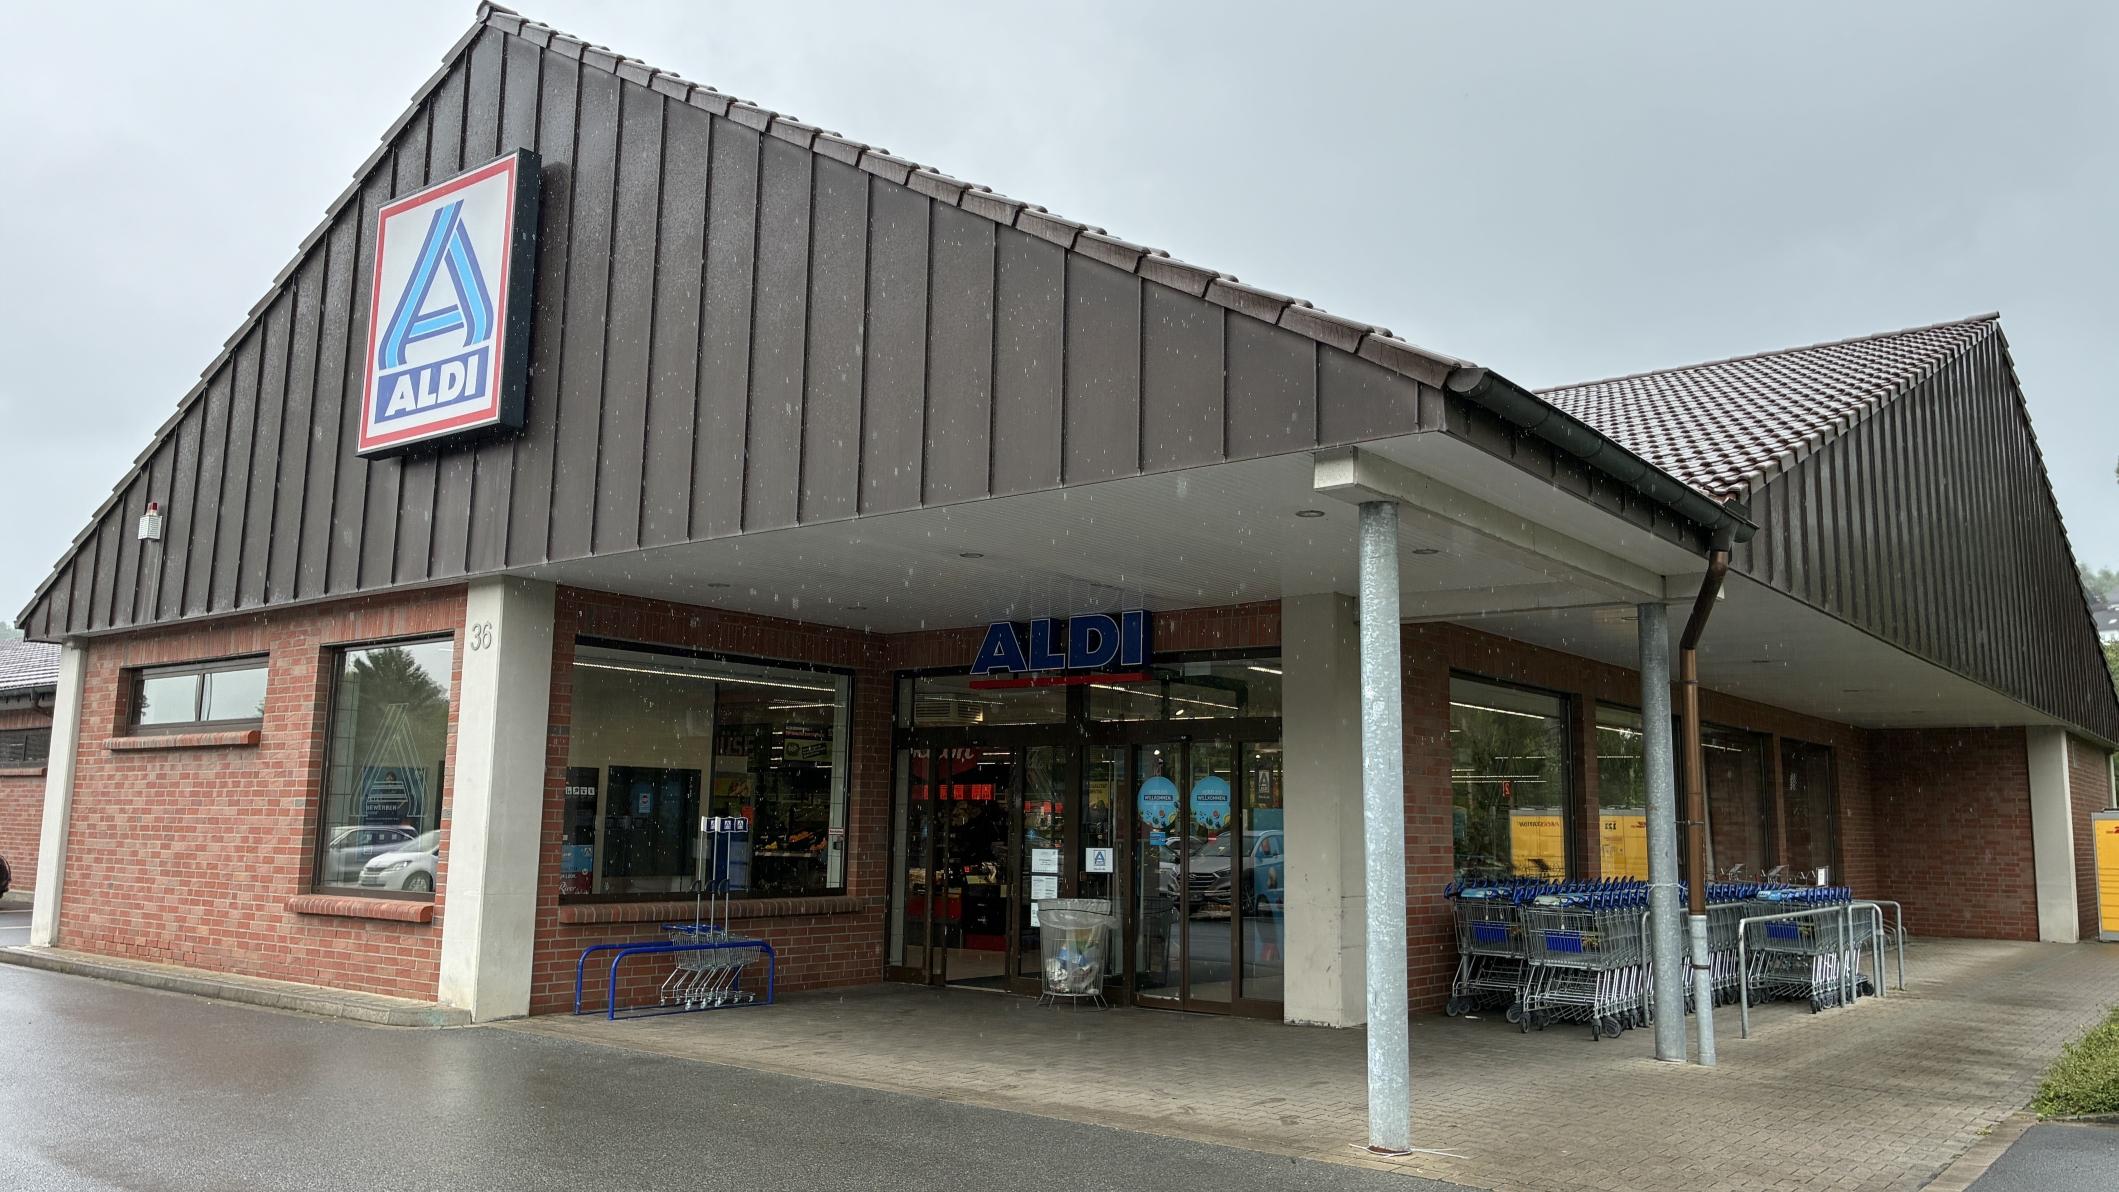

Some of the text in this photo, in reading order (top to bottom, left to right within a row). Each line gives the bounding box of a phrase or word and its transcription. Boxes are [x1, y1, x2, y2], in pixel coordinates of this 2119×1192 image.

[384, 355, 479, 417] ALDI
[470, 621, 493, 651] 36
[970, 609, 1151, 675] ALDI
